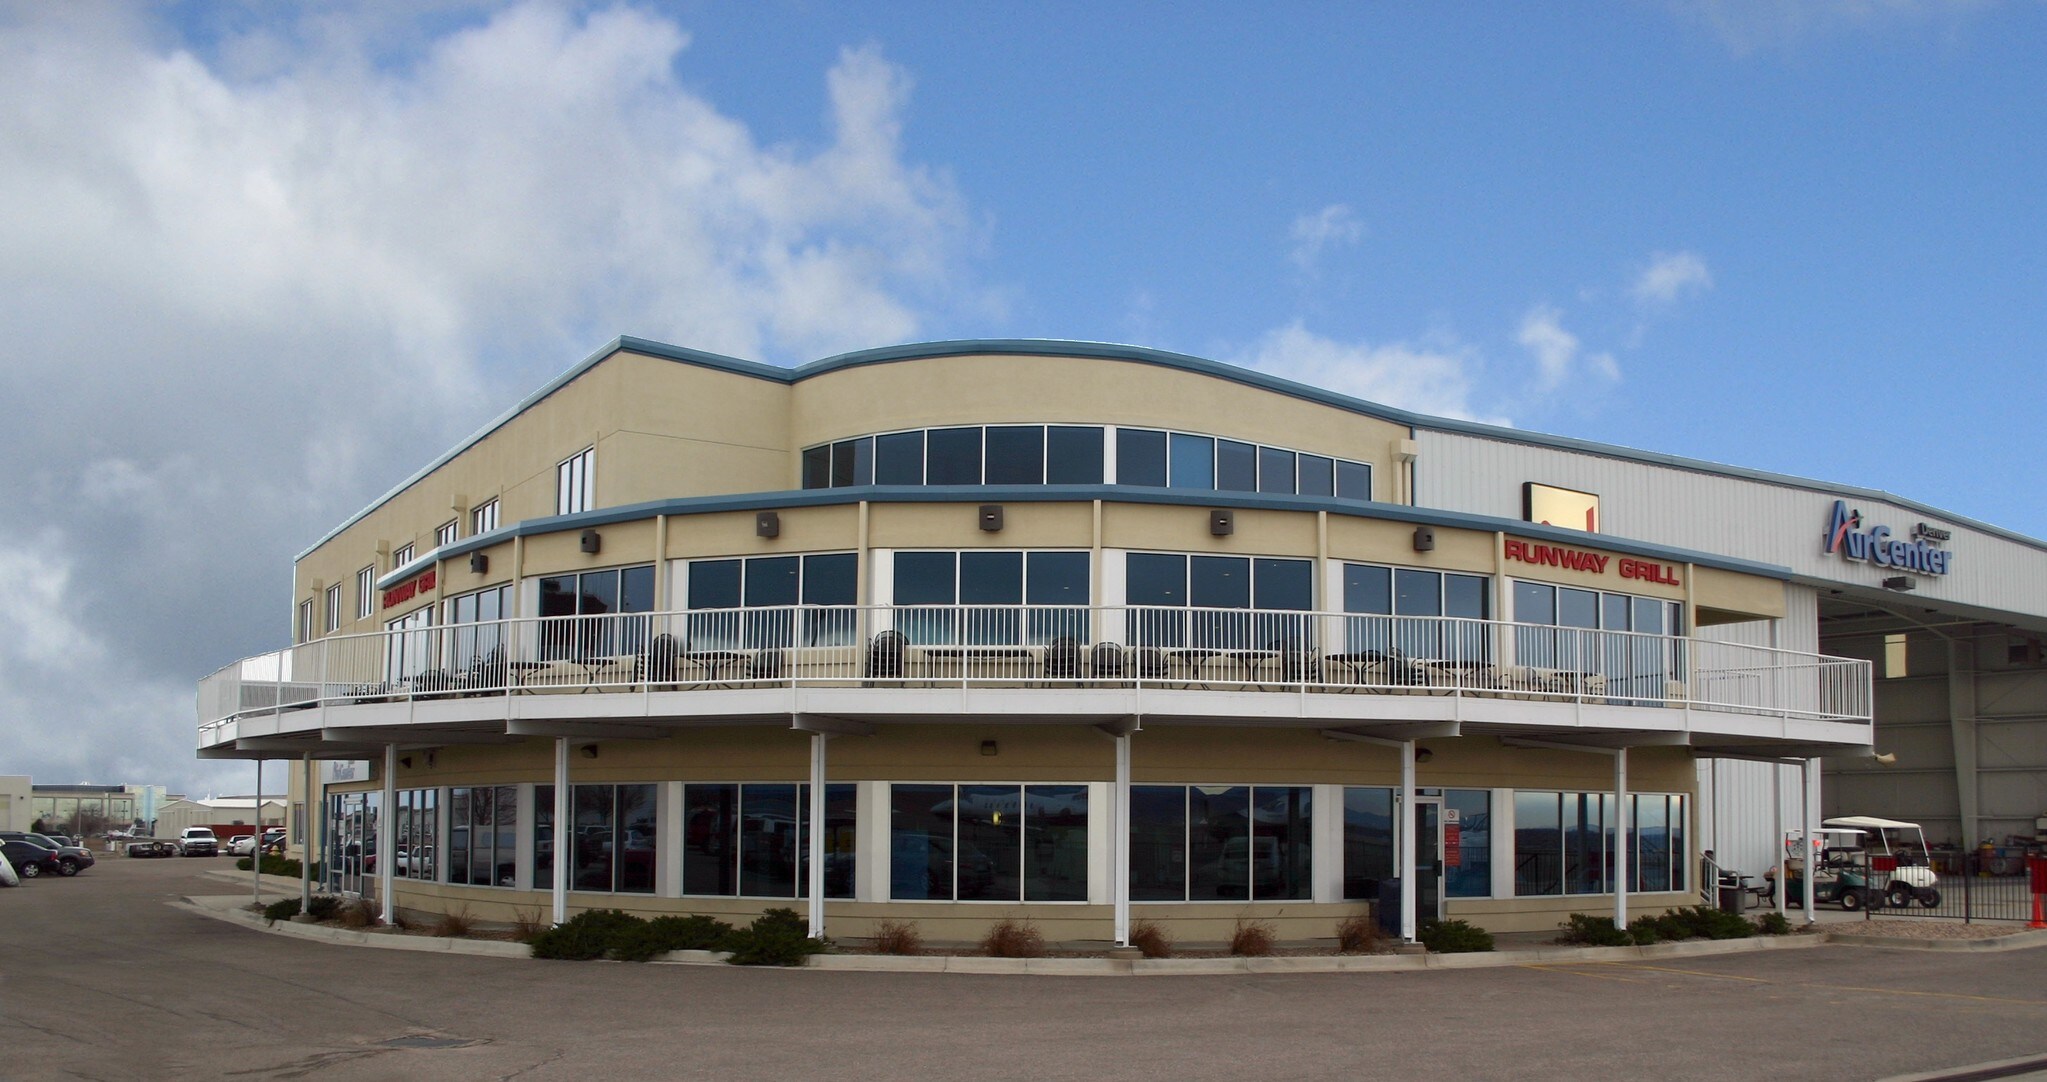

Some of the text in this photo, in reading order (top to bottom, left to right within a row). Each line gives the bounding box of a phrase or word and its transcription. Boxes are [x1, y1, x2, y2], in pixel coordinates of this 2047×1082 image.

[1825, 500, 1952, 576] AirCenter
[1918, 522, 1951, 541] Denver
[1505, 539, 1680, 586] RUNWAY GRILL
[383, 579, 417, 610] RUNWAY
